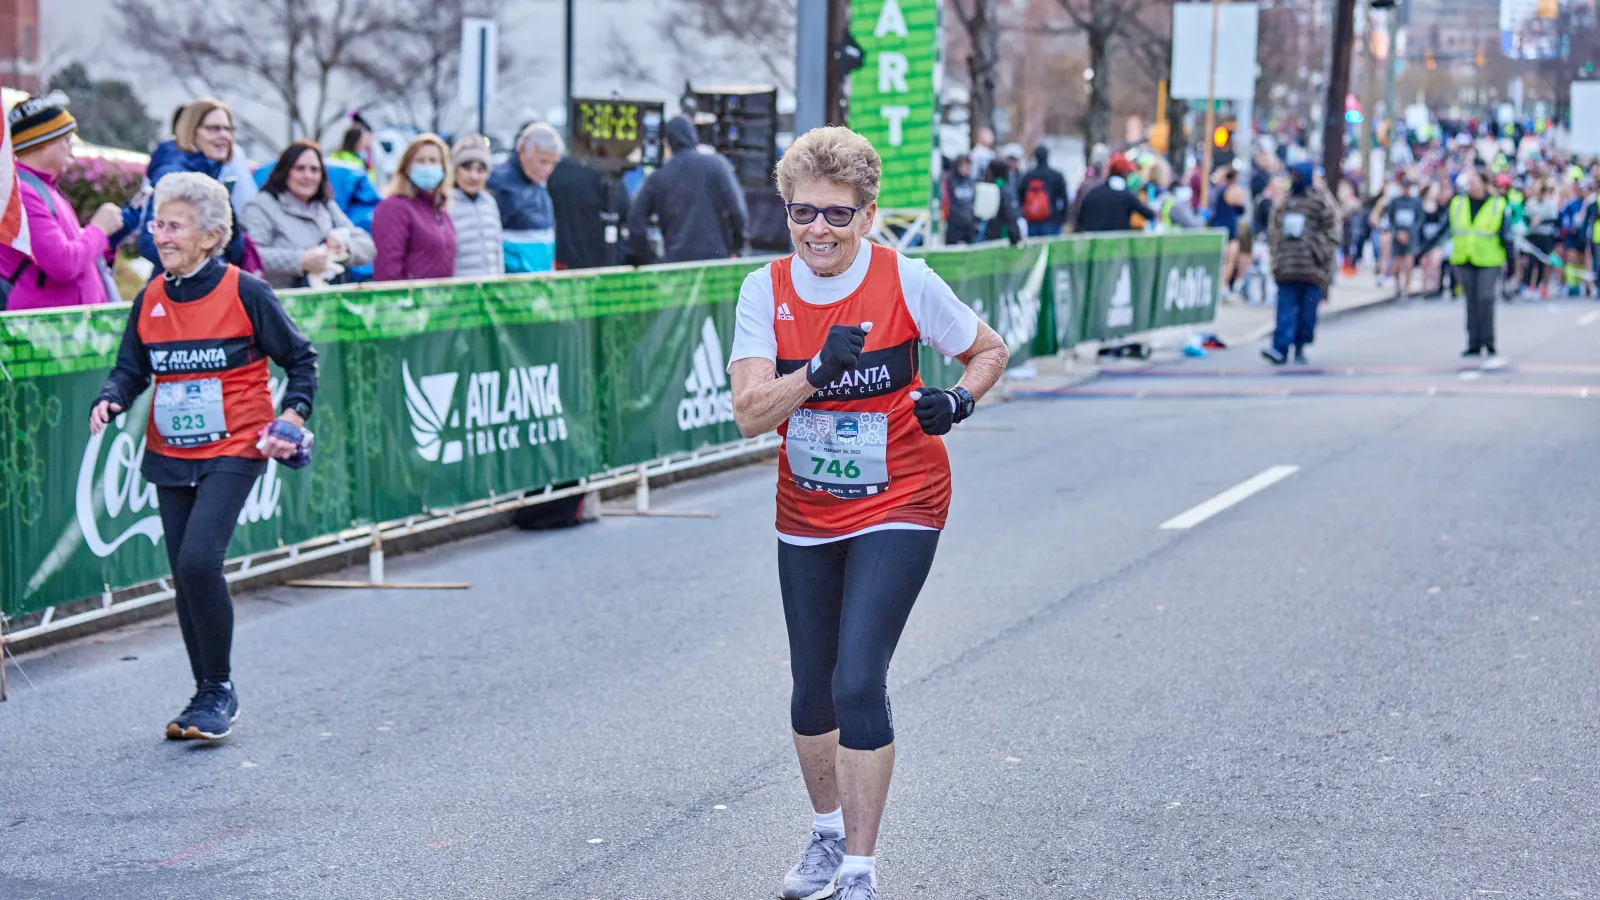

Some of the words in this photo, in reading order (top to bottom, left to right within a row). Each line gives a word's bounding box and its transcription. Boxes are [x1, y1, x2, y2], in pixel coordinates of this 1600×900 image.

[168, 347, 227, 364] ATLANTA
[168, 361, 198, 370] TRACK
[201, 359, 227, 369] CLUB
[465, 362, 563, 430] ATLANTA
[859, 381, 891, 394] CLUB
[172, 413, 205, 431] 823
[465, 424, 520, 457] TRACK
[528, 417, 568, 445] CLUB
[811, 456, 861, 479] 746
